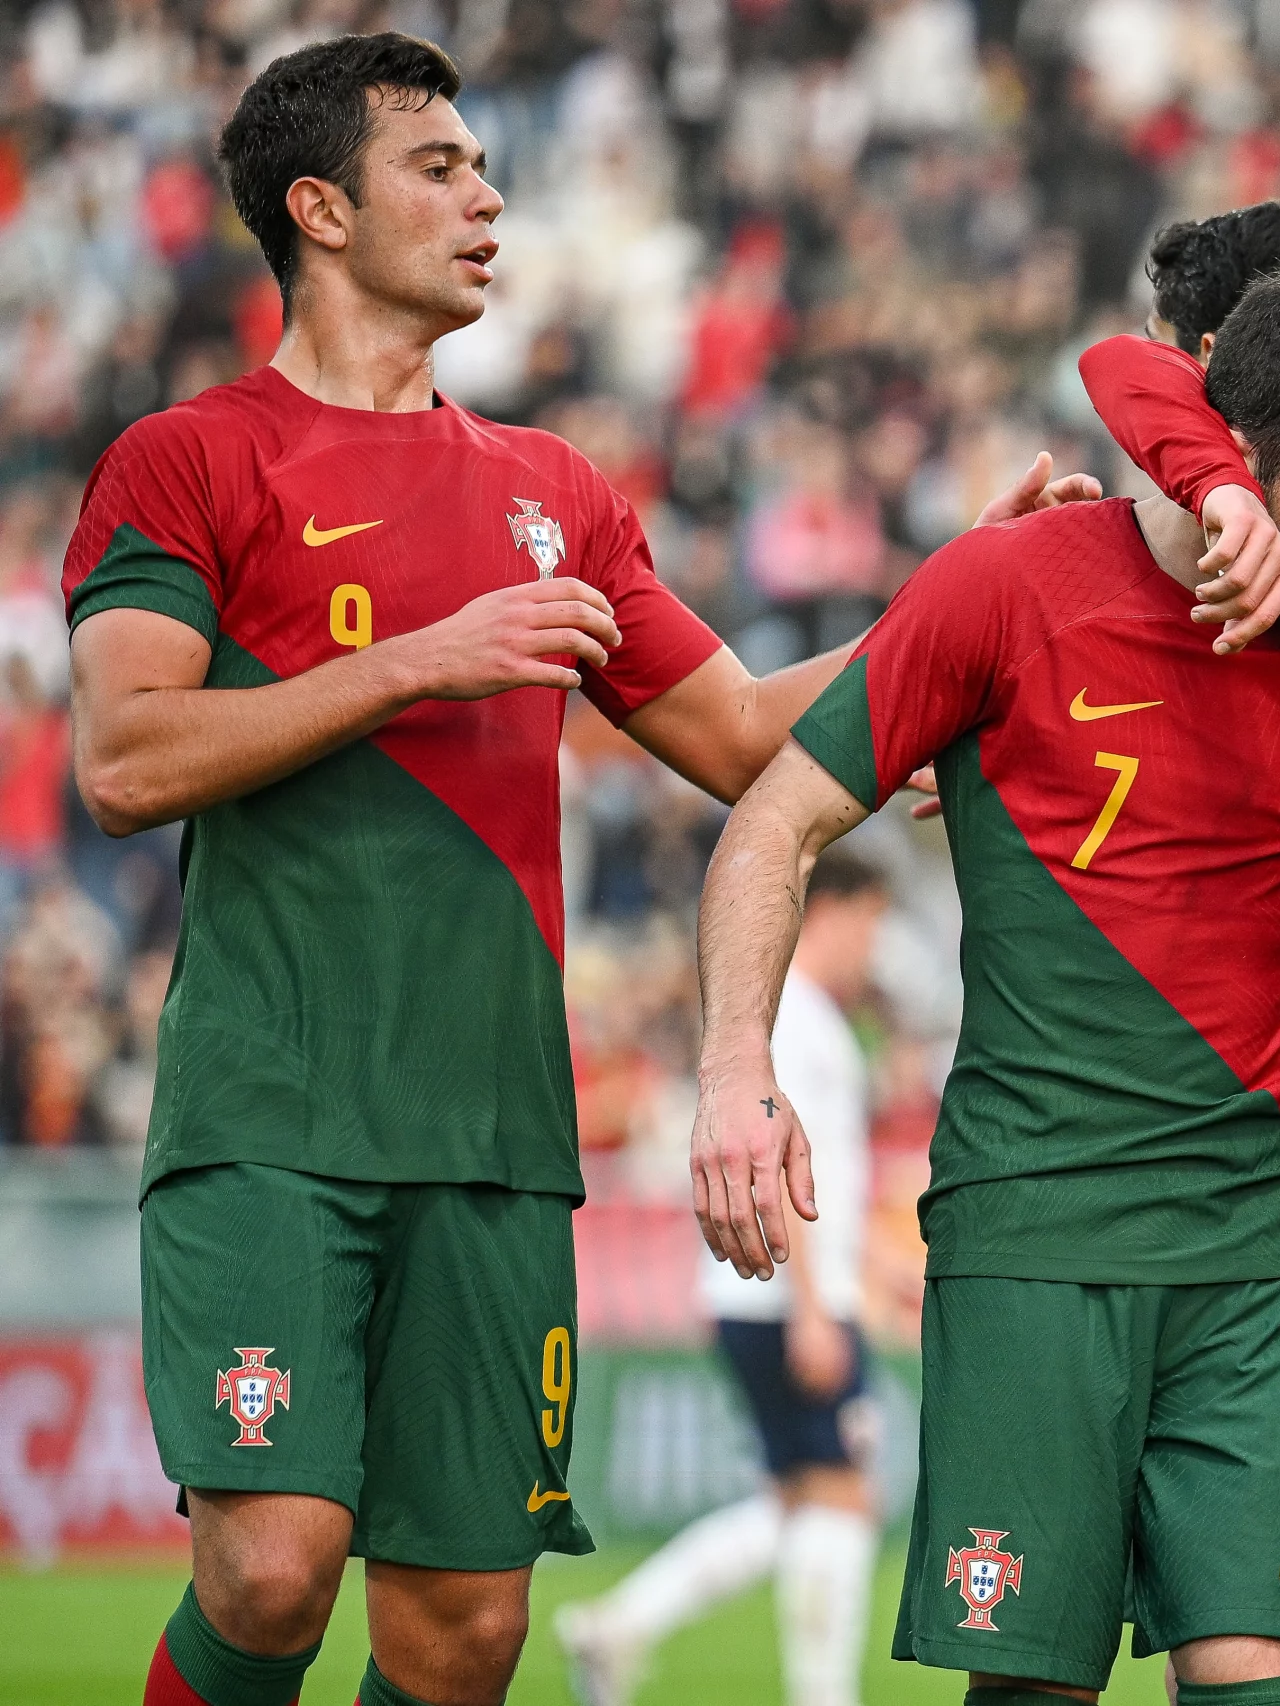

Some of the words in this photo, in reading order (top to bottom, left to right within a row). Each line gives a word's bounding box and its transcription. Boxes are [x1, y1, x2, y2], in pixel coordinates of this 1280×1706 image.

[330, 583, 373, 649] 9
[1071, 751, 1140, 870] 7
[542, 1326, 571, 1448] 9
